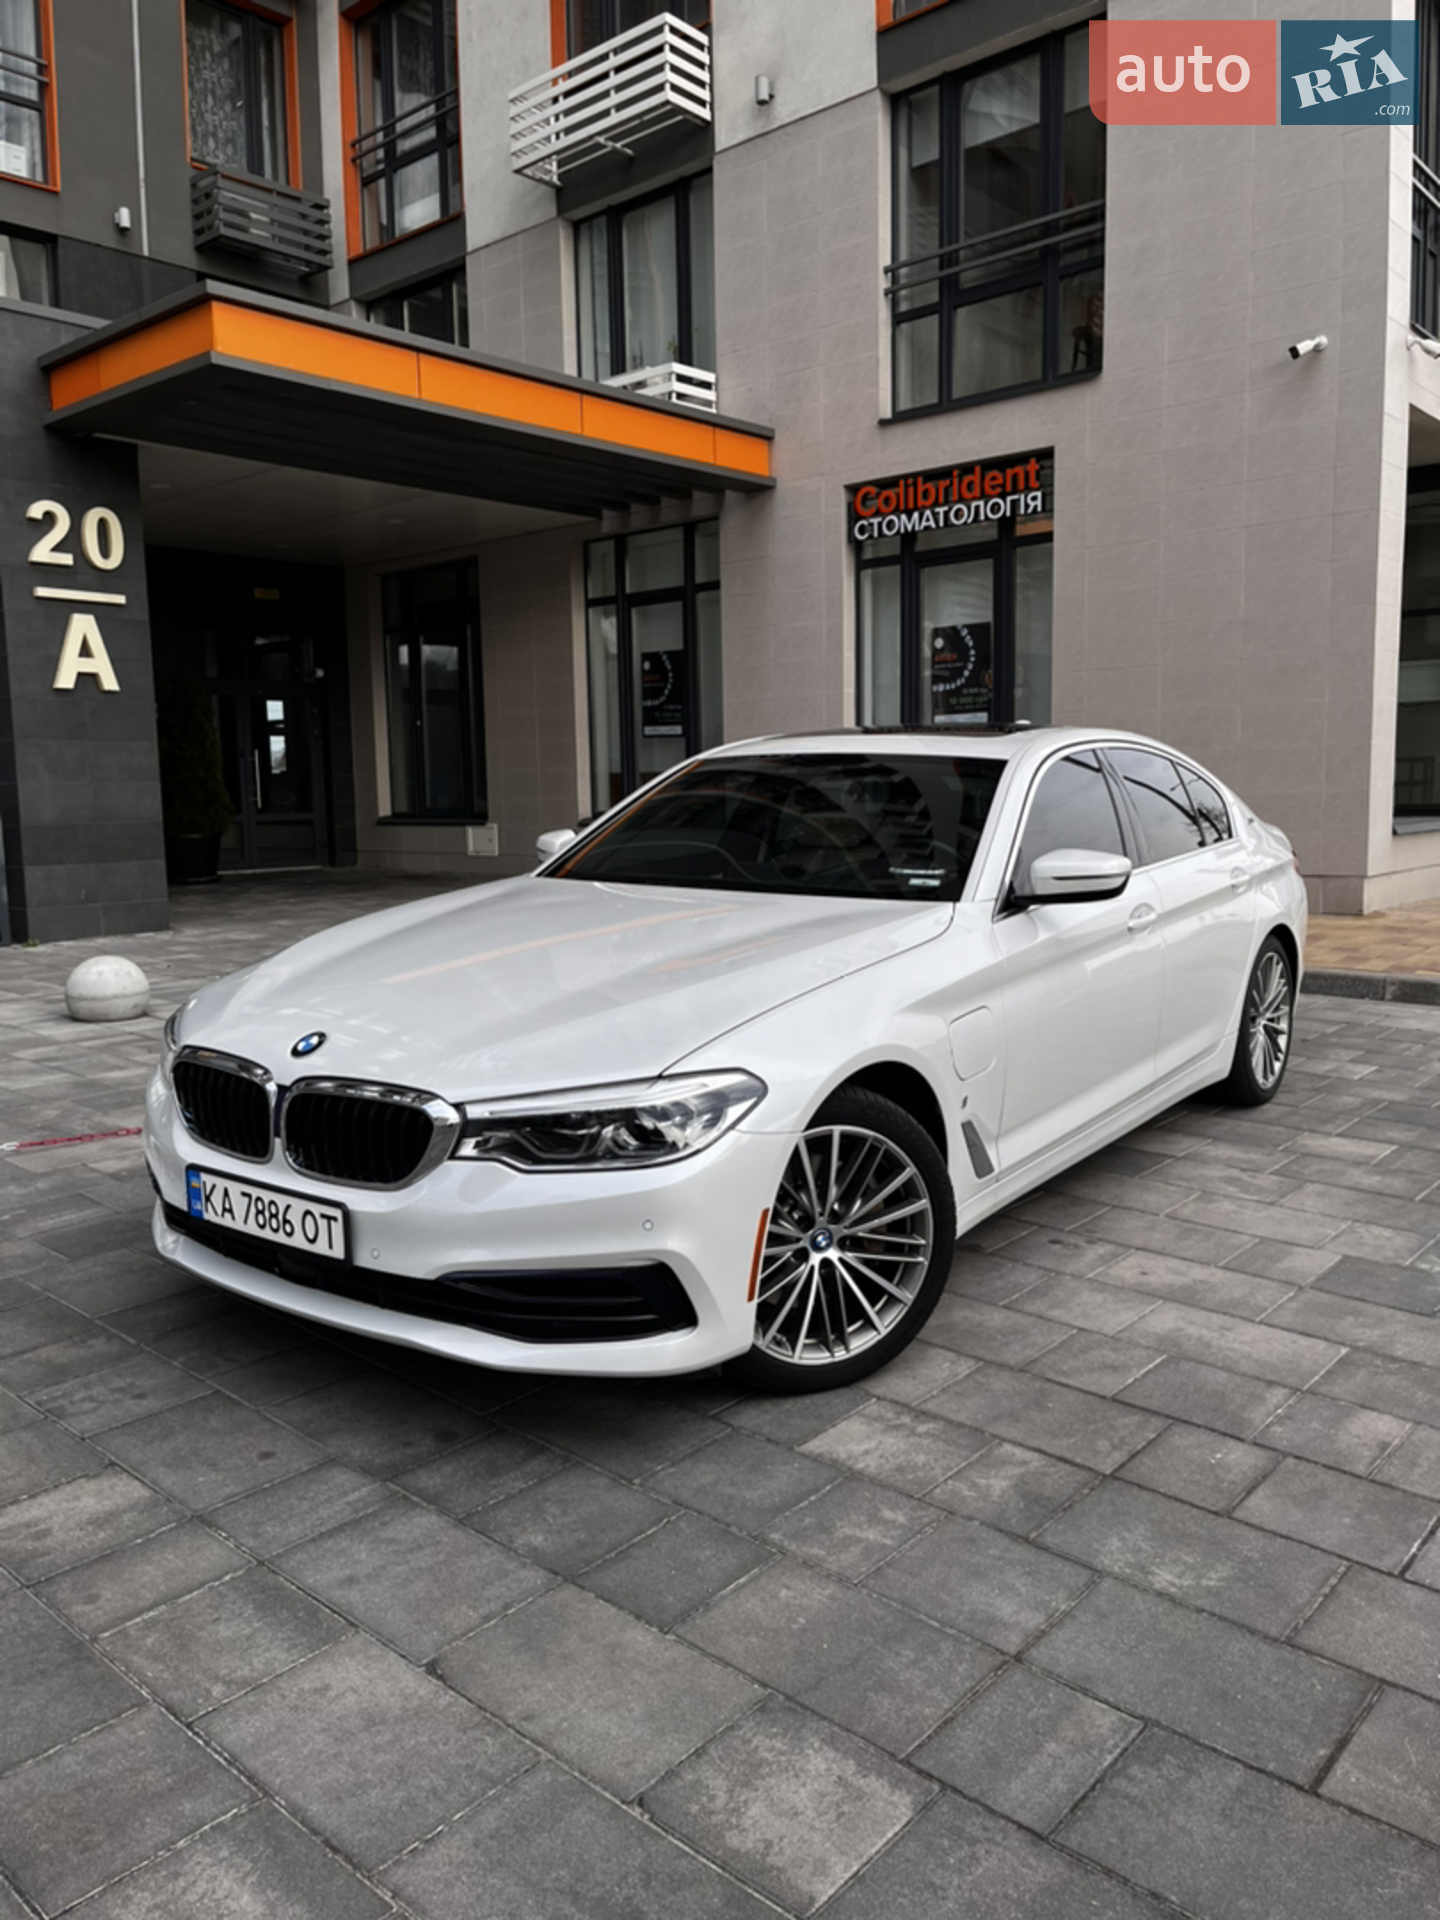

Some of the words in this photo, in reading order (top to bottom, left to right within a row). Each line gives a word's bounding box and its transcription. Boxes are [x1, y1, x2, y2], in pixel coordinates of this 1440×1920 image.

[854, 458, 1040, 517] Colibrident
[854, 490, 1042, 540] СТОМАТОЛОГІЯ
[26, 499, 125, 570] 20
[203, 1181, 236, 1221] KA
[240, 1191, 295, 1238] 7886
[301, 1209, 338, 1250] OT
